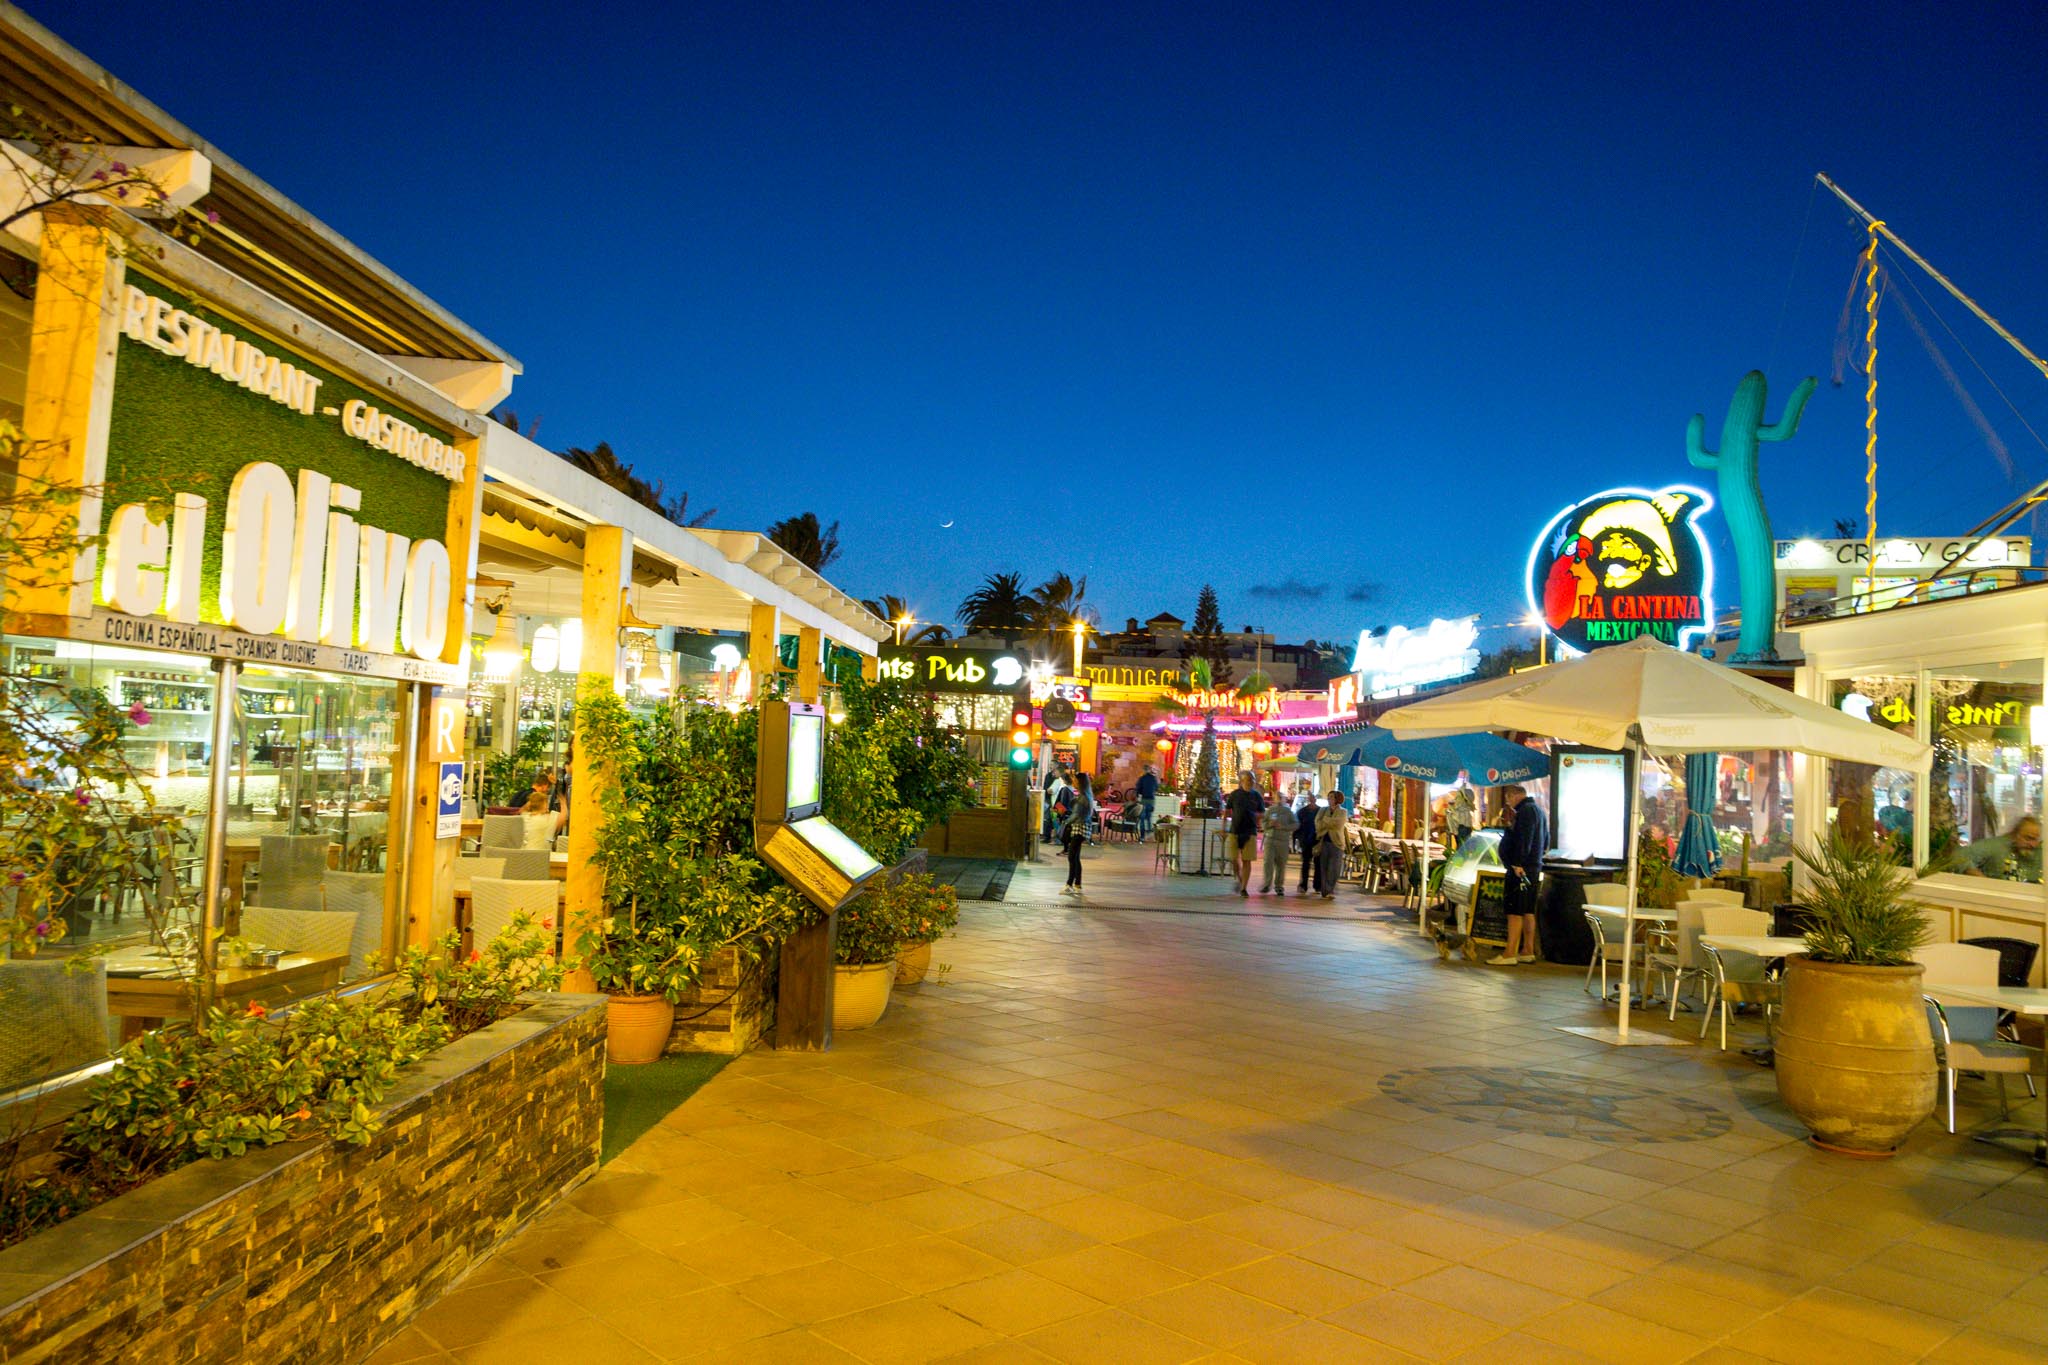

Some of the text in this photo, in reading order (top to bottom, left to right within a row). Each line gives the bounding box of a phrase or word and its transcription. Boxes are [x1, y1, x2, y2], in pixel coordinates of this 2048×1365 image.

[121, 284, 323, 415] RESTAURANT
[342, 399, 466, 482] GASTROBAR
[103, 461, 451, 660] el Olivo
[1579, 594, 1701, 619] LA CANTINA
[105, 617, 154, 643] COCINA
[160, 626, 217, 654] ESPAÑOLA
[236, 637, 277, 660] SPANISH
[282, 643, 317, 666] CUISINE
[1586, 621, 1675, 641] MEXICANA
[926, 655, 986, 683] Pub
[1162, 687, 1236, 709] owboat
[436, 706, 456, 753] R
[1402, 763, 1437, 779] pepsi
[1501, 766, 1531, 781] pepsi
